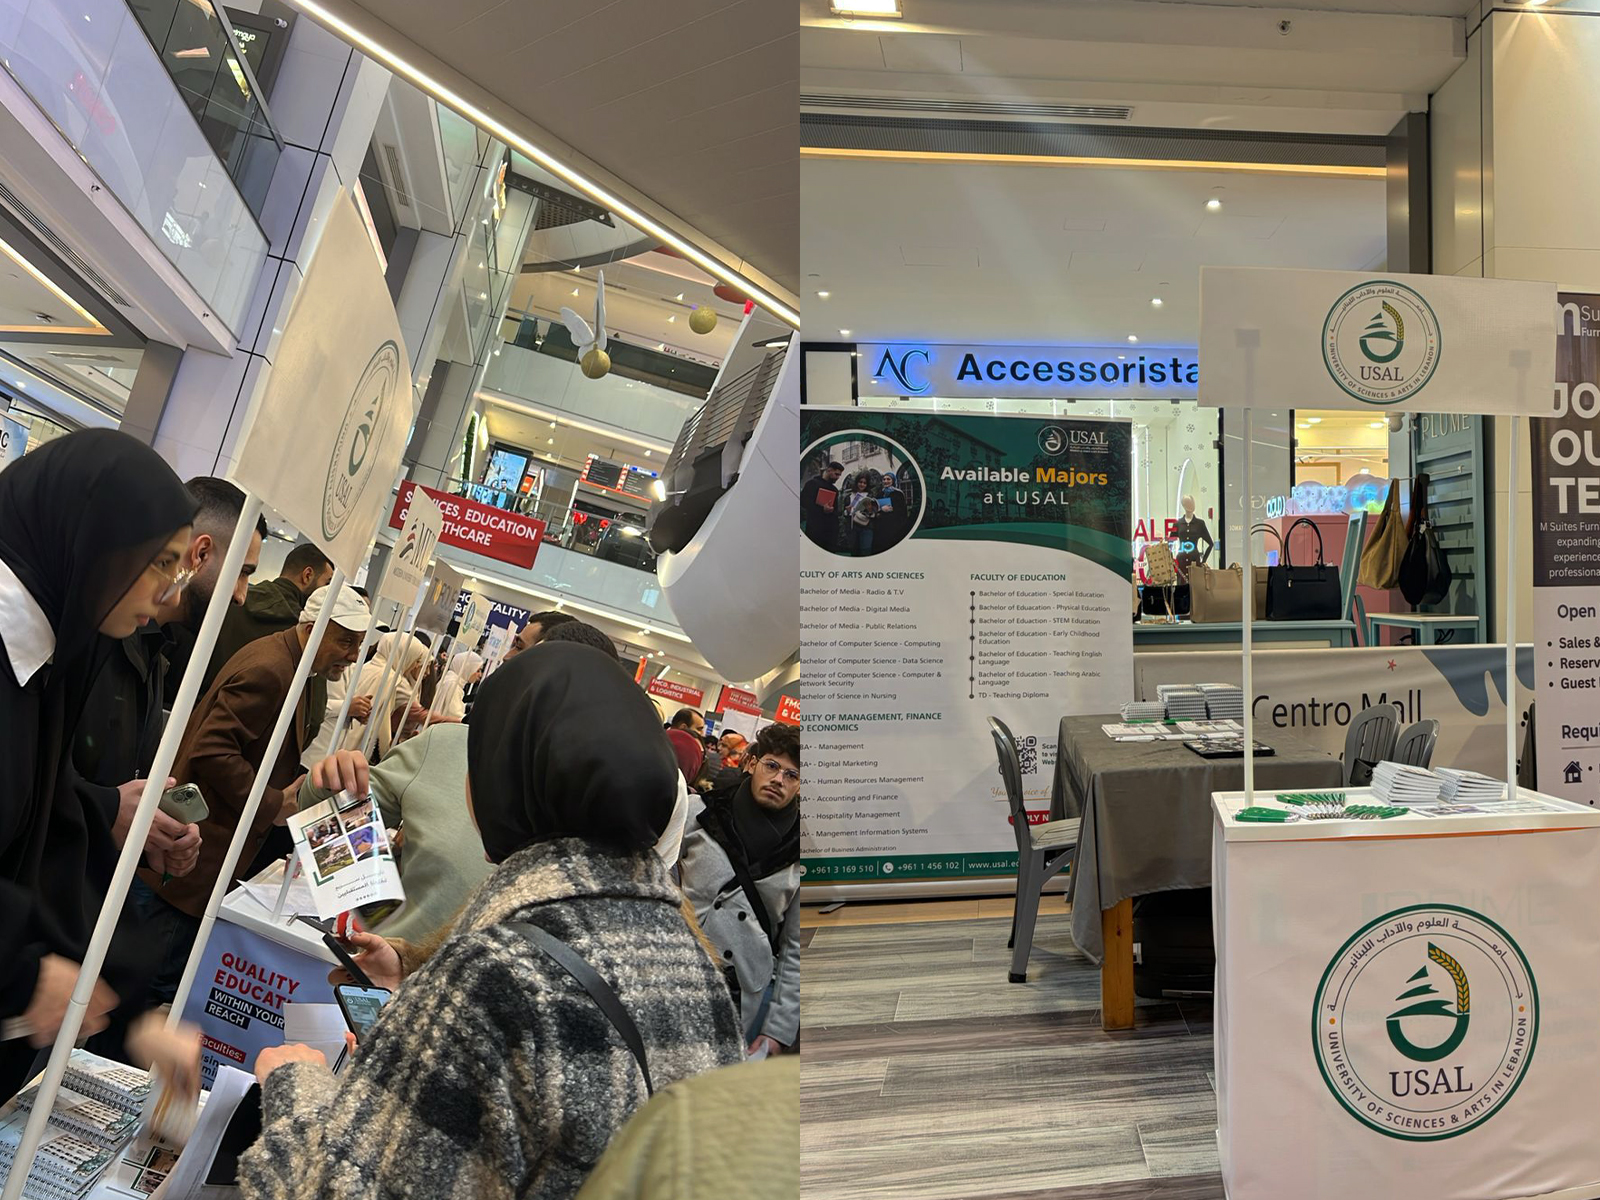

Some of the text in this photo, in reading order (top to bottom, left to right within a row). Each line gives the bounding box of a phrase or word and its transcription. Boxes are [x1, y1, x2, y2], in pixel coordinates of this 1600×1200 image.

[957, 353, 1198, 383] Accessorista
[1330, 343, 1434, 398] UNIVERSITY OF SCIENCES ARTS LEBANON
[1360, 366, 1403, 381] USAL
[1554, 382, 1600, 418] JO
[1422, 413, 1471, 440] PLUME
[1070, 430, 1108, 444] USAL
[940, 466, 1108, 488] Available Majors
[983, 491, 1069, 505] at USAL
[1550, 478, 1600, 513] TE
[405, 491, 460, 520] SICES,
[465, 509, 537, 540] EDUCATION
[1540, 522, 1577, 531] M Suites
[1557, 537, 1600, 548] expanding
[886, 572, 925, 580] SCIENCES
[1549, 567, 1600, 579] professiona
[1558, 604, 1596, 621] Open
[1559, 636, 1600, 649] Sales &
[1560, 658, 1600, 669] Reserv
[1561, 677, 1596, 689] Guest
[839, 713, 903, 721] MANAGEMENT,
[807, 724, 859, 732] ECONOMICS
[817, 811, 900, 820] Hospitality Management
[860, 828, 900, 836] Information
[842, 865, 856, 873] 169
[898, 863, 917, 871] +961
[927, 862, 942, 870] 456
[1377, 922, 1413, 943] والآداب
[1417, 918, 1449, 932] العلوم
[222, 953, 300, 995] QUALITY
[214, 969, 293, 1009] EDUCAT
[209, 1004, 245, 1026] REACH
[214, 990, 285, 1028] WITHIN YOUR
[1328, 1017, 1526, 1128] UNIVERSITY OF SCIENCES & ARTS IN LEBANON
[1389, 1066, 1473, 1097] USAL
